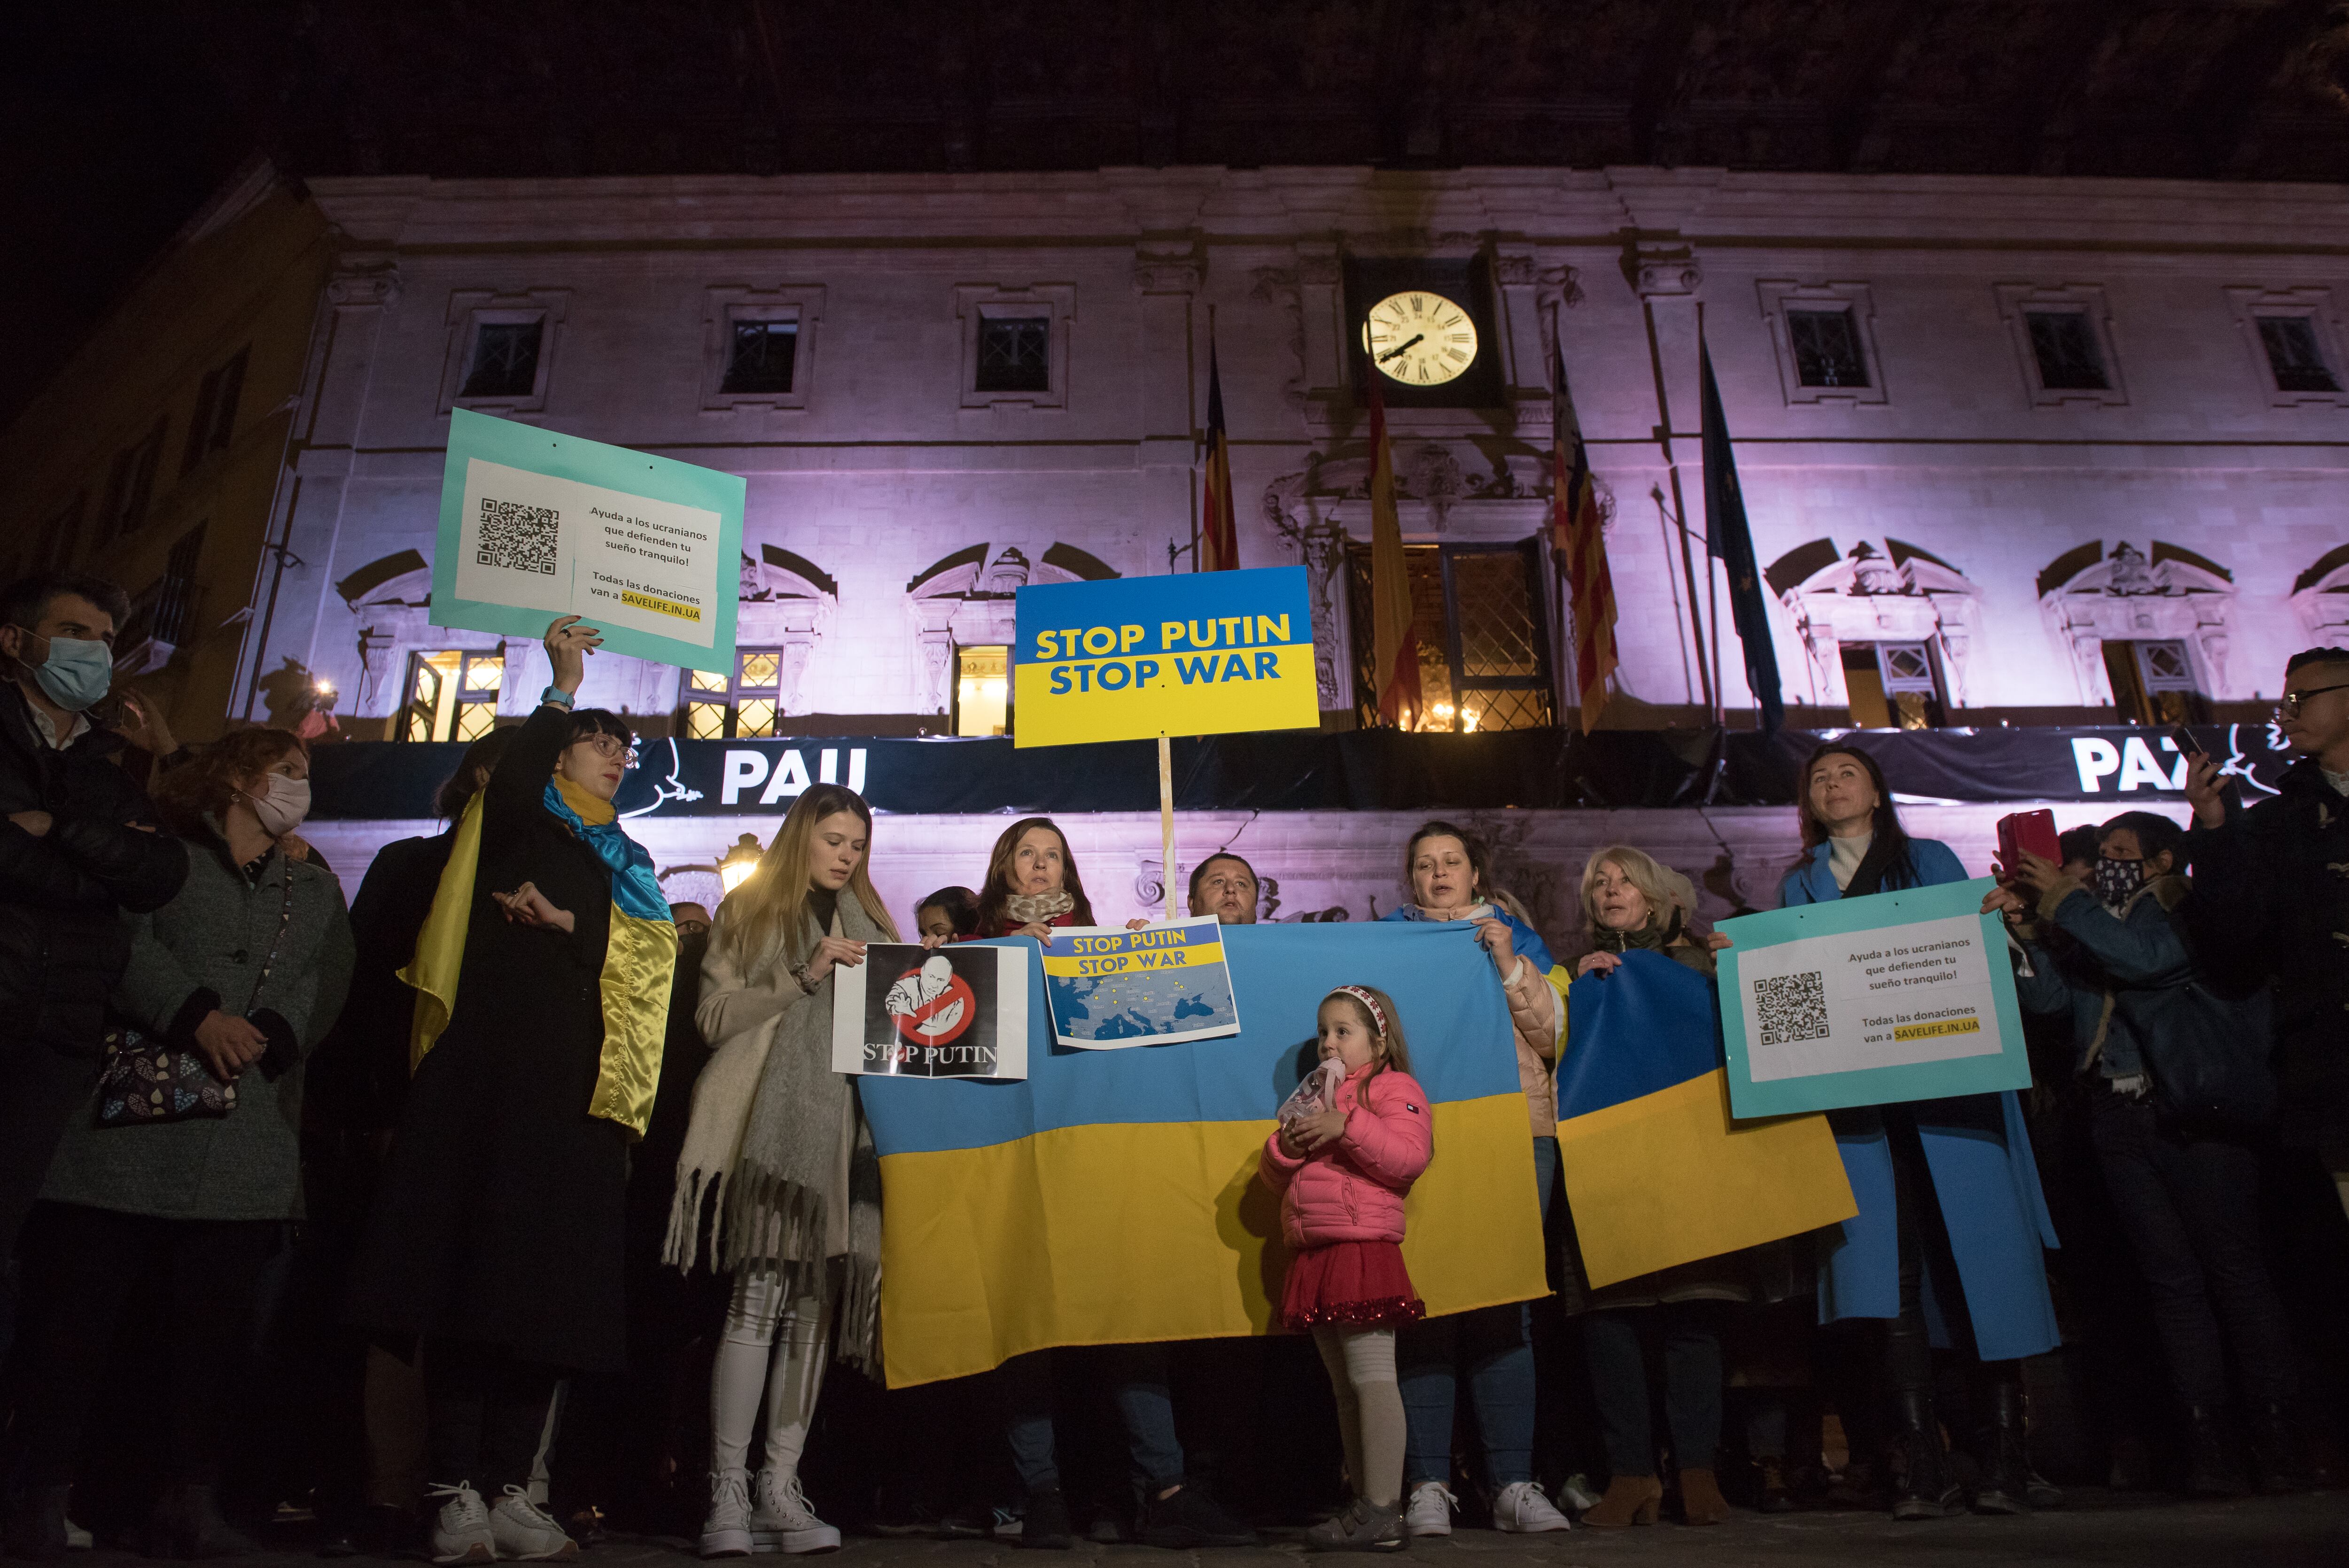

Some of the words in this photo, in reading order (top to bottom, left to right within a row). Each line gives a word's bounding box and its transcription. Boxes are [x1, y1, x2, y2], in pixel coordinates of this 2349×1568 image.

[605, 526, 624, 536] que
[627, 530, 677, 549] defienden
[681, 543, 691, 552] tu
[636, 517, 649, 528] los
[653, 523, 707, 540] ucranianos
[606, 541, 636, 553] sueño
[639, 548, 688, 566] tranquilo!
[593, 571, 623, 585] Todas
[627, 579, 640, 590] las
[643, 584, 700, 604] donaciones
[591, 588, 609, 598] van
[622, 593, 700, 620] SAVELIFE.IN.UA
[1036, 625, 1145, 659] STOP
[1161, 613, 1290, 649] PUTIN
[1050, 660, 1159, 694] STOP
[1174, 652, 1281, 685] WAR
[1073, 937, 1122, 953] STOP
[1130, 929, 1186, 948] PUTIN
[1894, 947, 1908, 956] los
[1912, 939, 1970, 954] ucranianos
[1079, 956, 1128, 974] STOP
[1136, 951, 1187, 968] WAR
[1866, 967, 1885, 976] que
[1889, 959, 1942, 972] defienden
[1870, 979, 1901, 990] sueño
[1904, 970, 1957, 985] tranquilo!
[1862, 1017, 1893, 1027] Todas
[1897, 1014, 1911, 1023] las
[1914, 1007, 1976, 1021] donaciones
[1864, 1034, 1883, 1043] van
[1895, 1021, 1980, 1040] SAVELIFE.IN.UA
[924, 1046, 997, 1064] PUTIN
